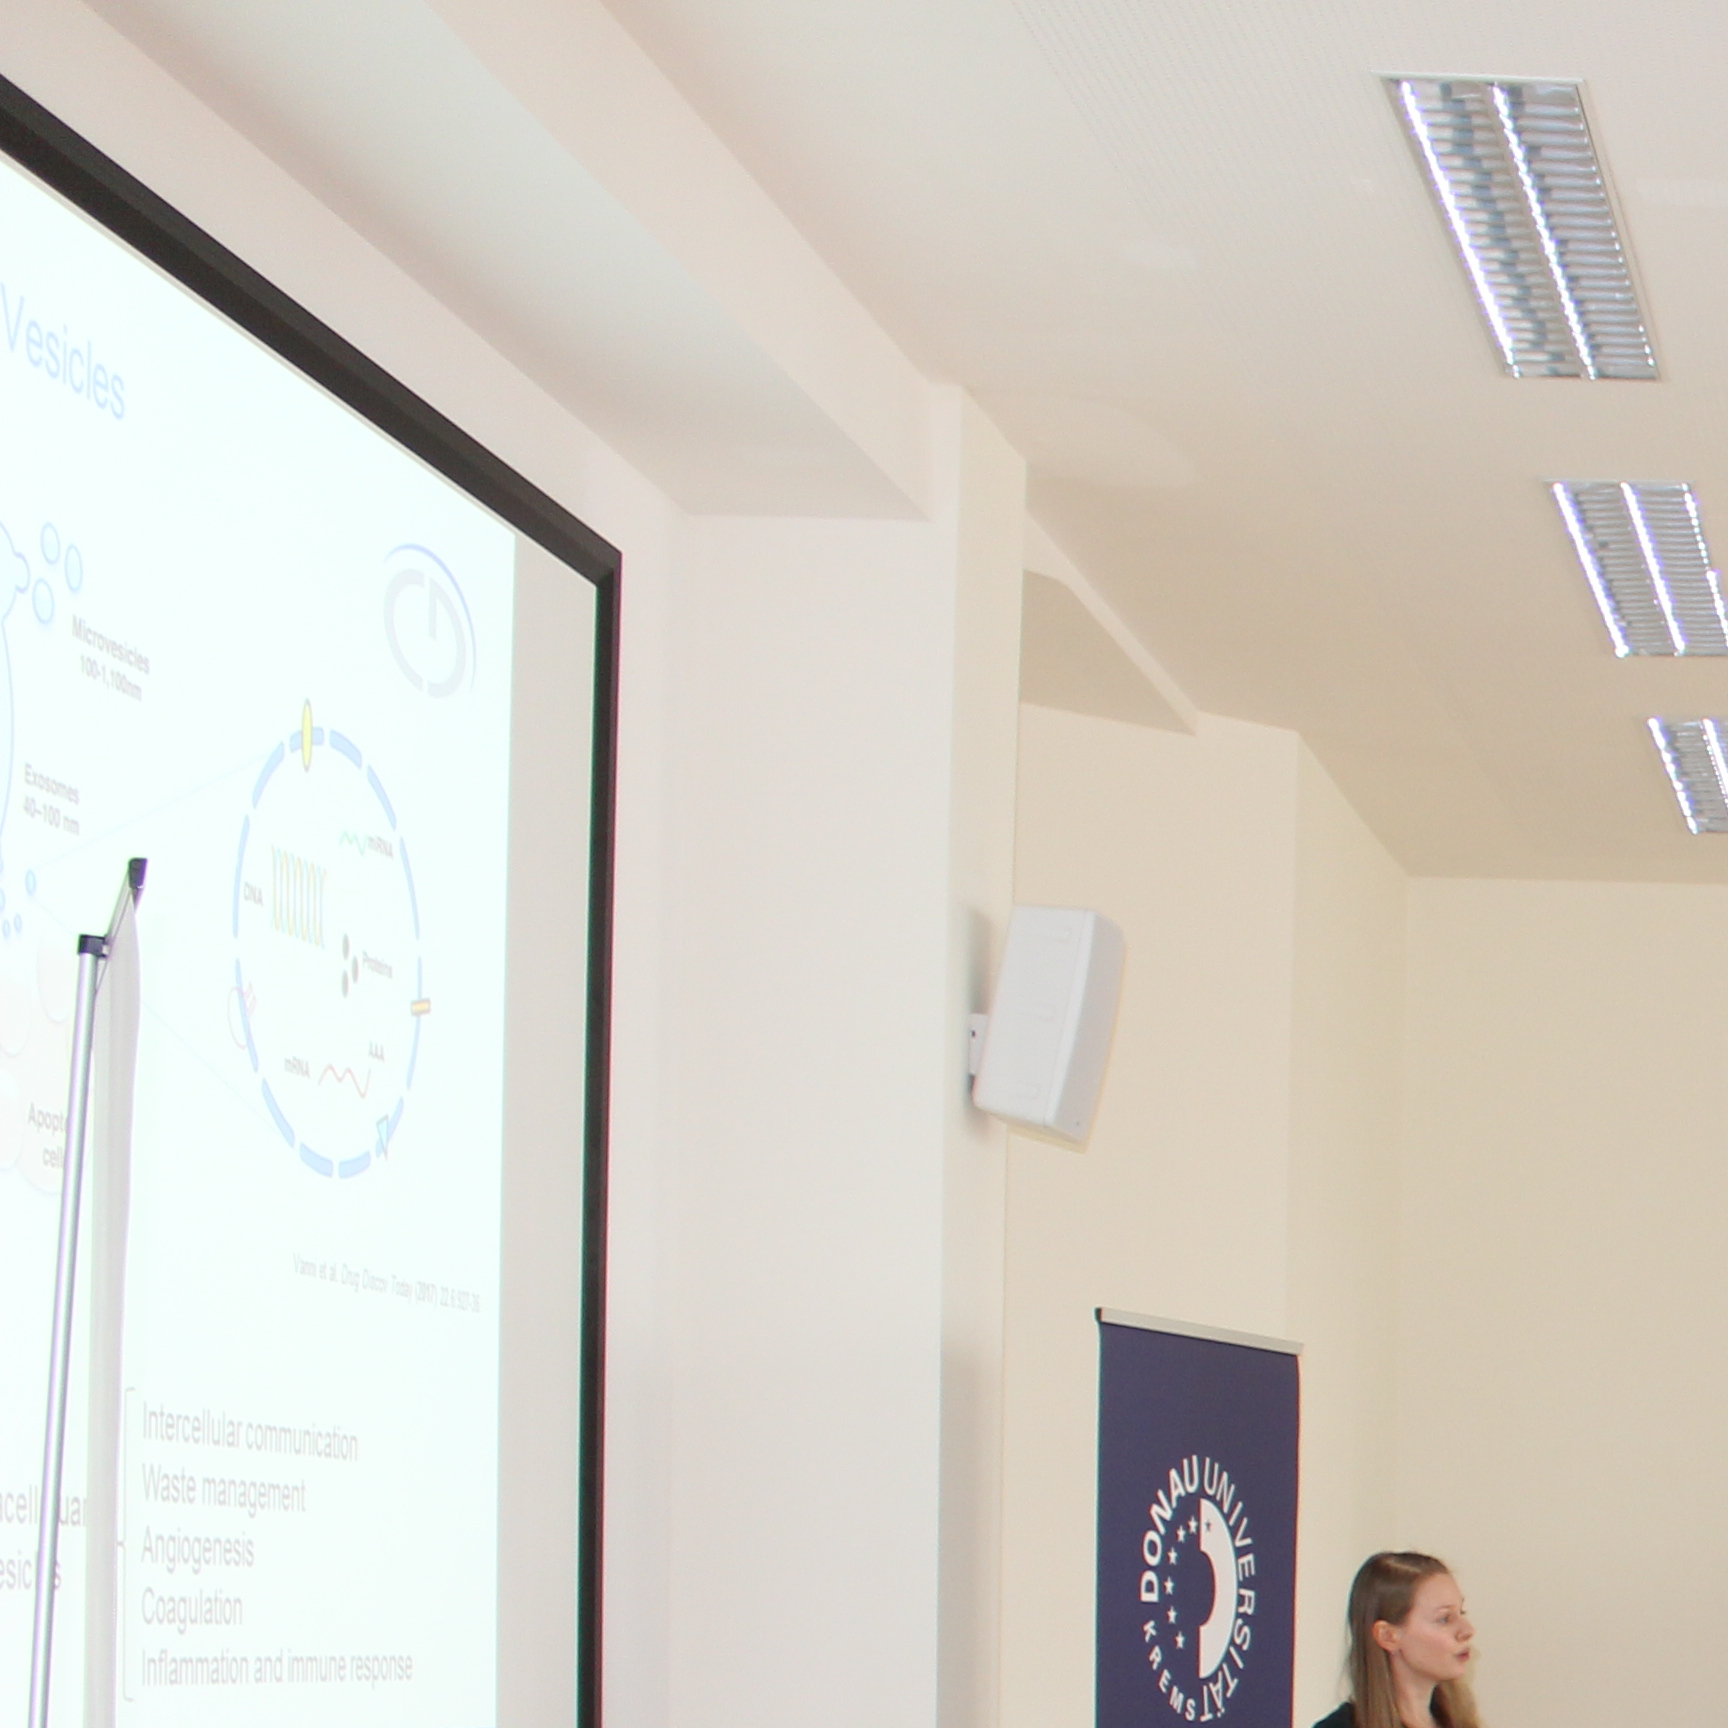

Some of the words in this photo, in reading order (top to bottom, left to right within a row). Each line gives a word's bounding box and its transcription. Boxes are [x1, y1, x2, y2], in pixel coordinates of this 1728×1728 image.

[0, 281, 126, 421] Vesicles
[71, 613, 151, 677] Microvesicles
[23, 761, 80, 806] Exosomes
[142, 1398, 244, 1450] Intercellular
[244, 1420, 359, 1463] communication
[142, 1461, 197, 1505] Waste
[201, 1477, 306, 1520] management
[141, 1524, 256, 1575] Angiogenesis
[1139, 1454, 1200, 1603] DONAU
[142, 1586, 243, 1636] Coagulation
[1200, 1455, 1257, 1723] UNIVERSITÄT
[142, 1647, 250, 1687] Inflammation
[253, 1647, 283, 1685] and
[287, 1648, 347, 1685] immune
[349, 1652, 415, 1691] response
[1142, 1619, 1197, 1722] KREMS
